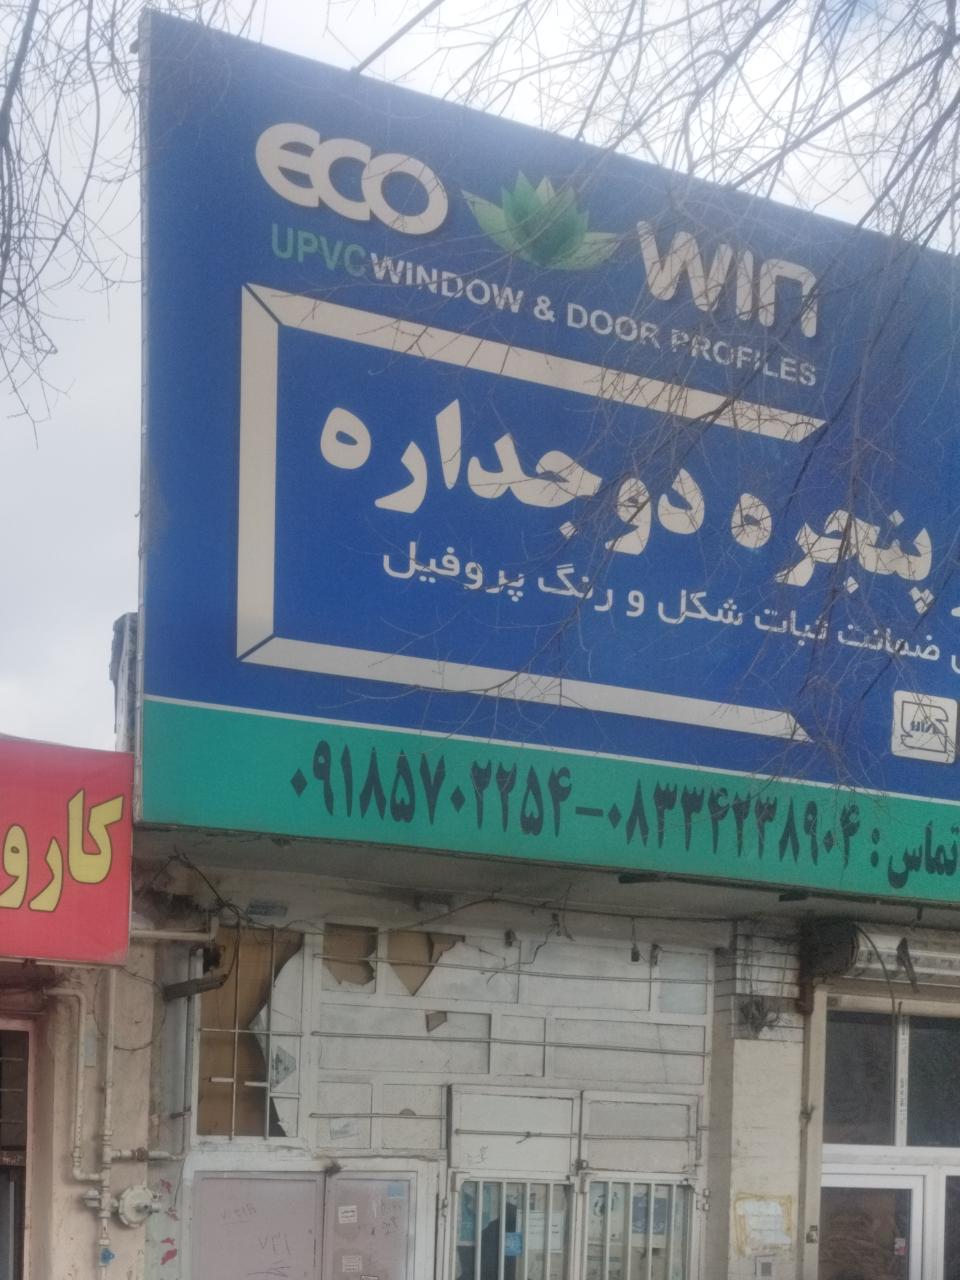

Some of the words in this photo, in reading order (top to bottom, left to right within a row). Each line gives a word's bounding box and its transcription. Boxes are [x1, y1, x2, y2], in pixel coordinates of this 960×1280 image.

[534, 296, 556, 322] &
[567, 304, 662, 350] DOOR
[671, 329, 817, 387] PROFILES
[537, 564, 613, 612] رنگ
[626, 588, 645, 617] و
[658, 590, 744, 625] شکل
